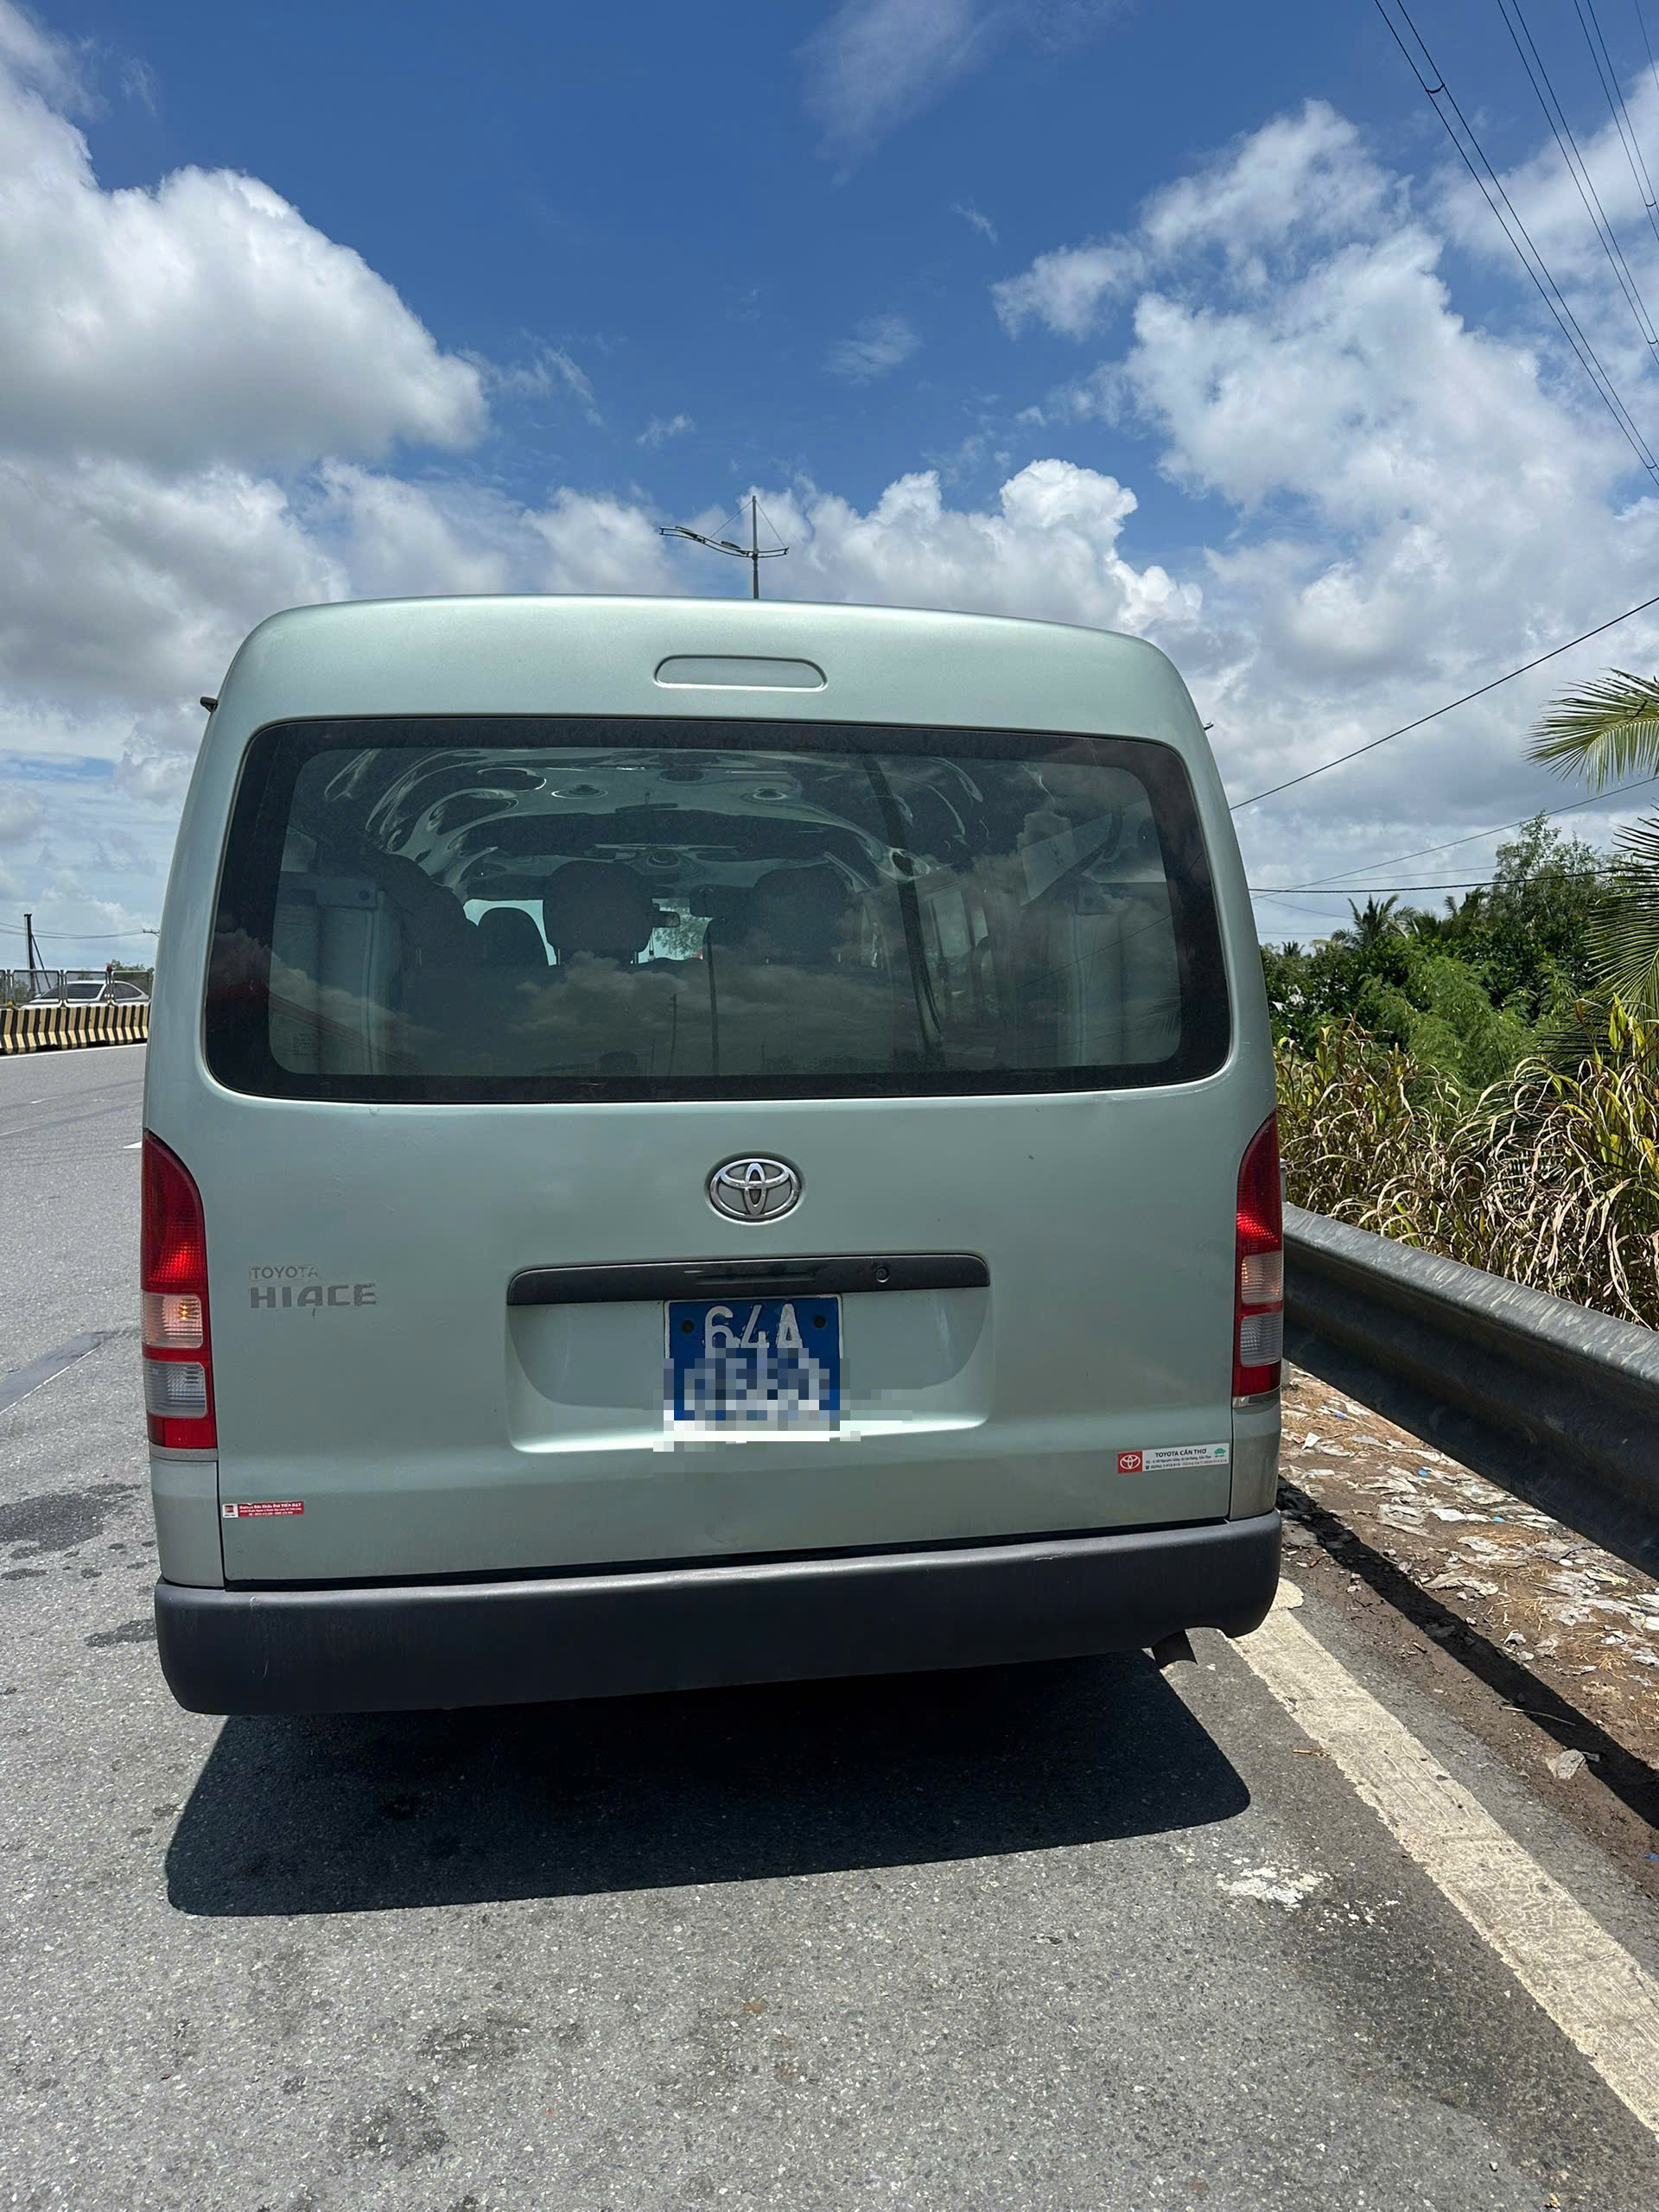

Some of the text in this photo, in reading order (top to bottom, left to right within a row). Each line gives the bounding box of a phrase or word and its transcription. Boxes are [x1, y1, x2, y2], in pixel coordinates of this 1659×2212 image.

[251, 1266, 319, 1279] TOYOTA
[251, 1283, 377, 1308] HIACE
[703, 1303, 804, 1350] 64A
